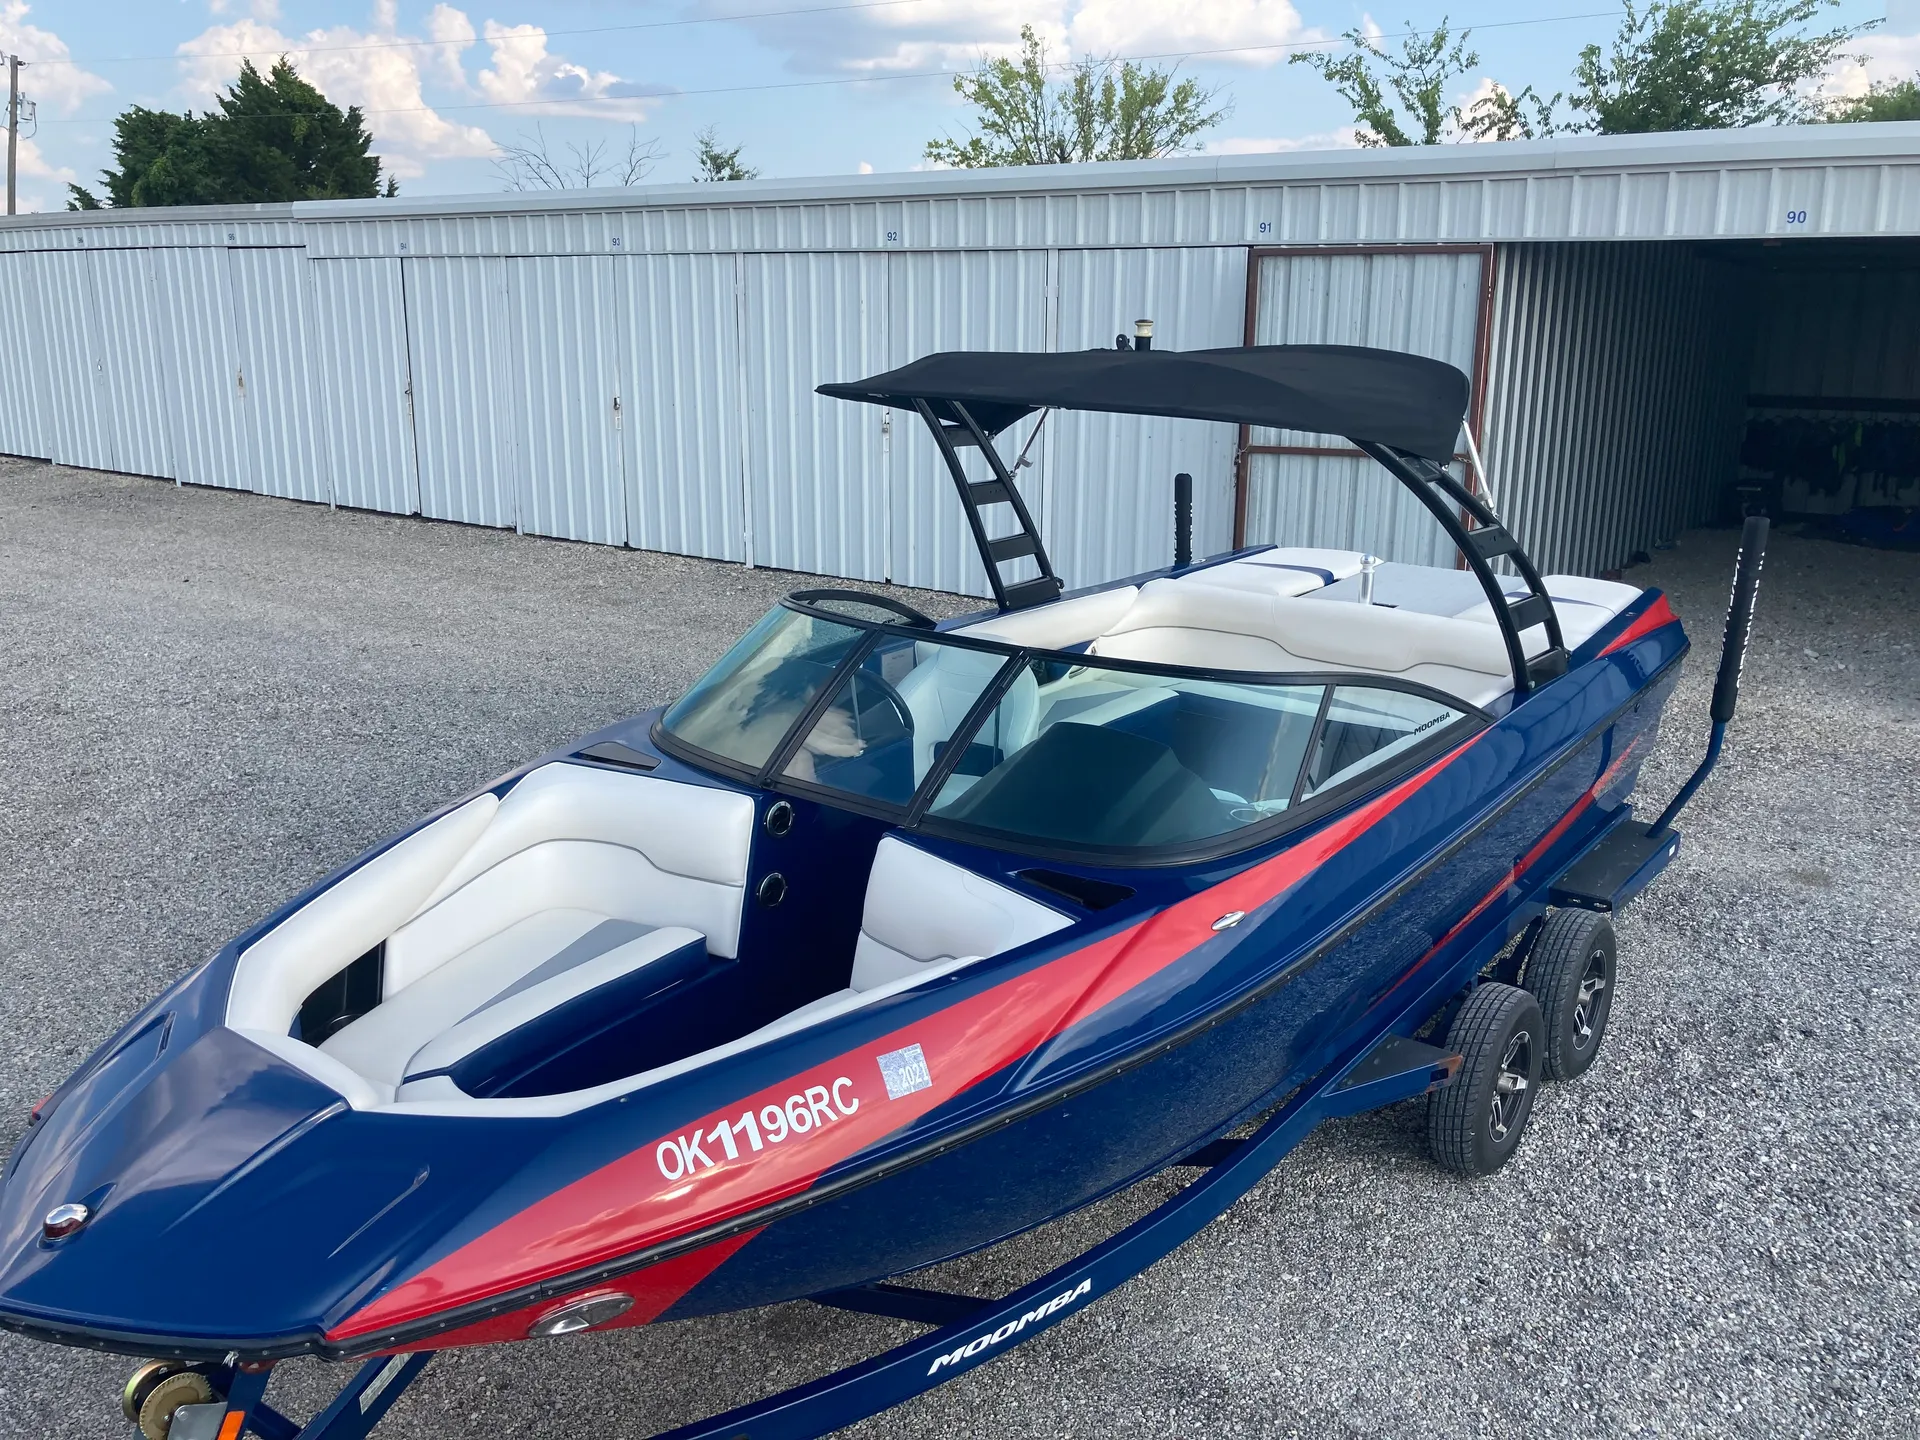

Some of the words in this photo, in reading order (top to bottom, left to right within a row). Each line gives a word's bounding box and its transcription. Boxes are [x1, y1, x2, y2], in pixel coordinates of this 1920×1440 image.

[1786, 210, 1807, 224] 90
[1259, 222, 1272, 233] 91
[612, 237, 621, 246] 93
[887, 231, 898, 241] 92
[1413, 711, 1451, 736] MOOMBA
[926, 1277, 1092, 1377] MOOMBA
